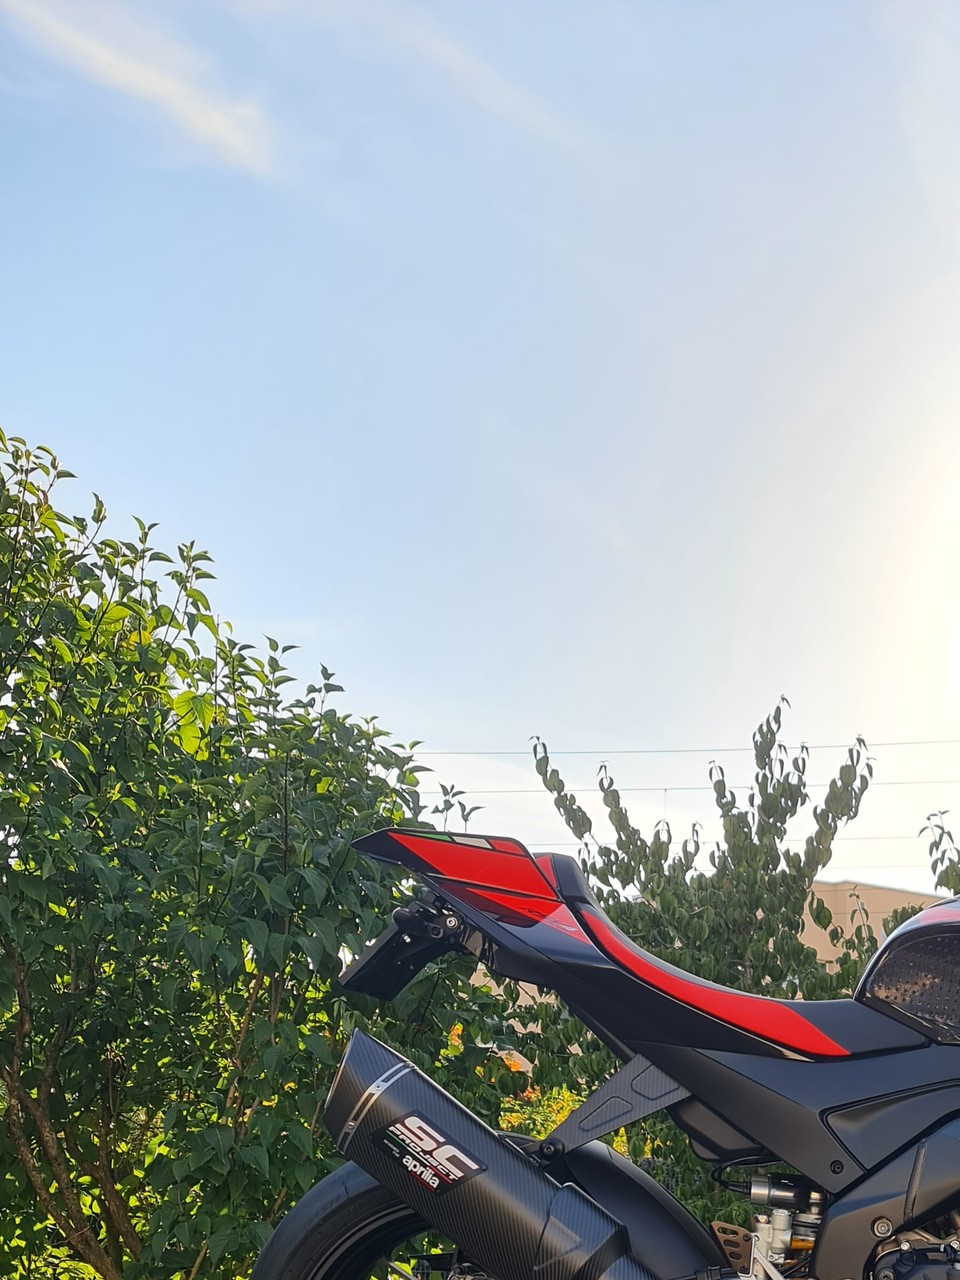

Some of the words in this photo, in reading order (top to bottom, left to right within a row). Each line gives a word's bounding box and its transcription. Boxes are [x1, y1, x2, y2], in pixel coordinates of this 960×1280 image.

[388, 1126, 459, 1180] PROJECT
[395, 1116, 480, 1179] SC
[402, 1154, 440, 1188] aprilia
